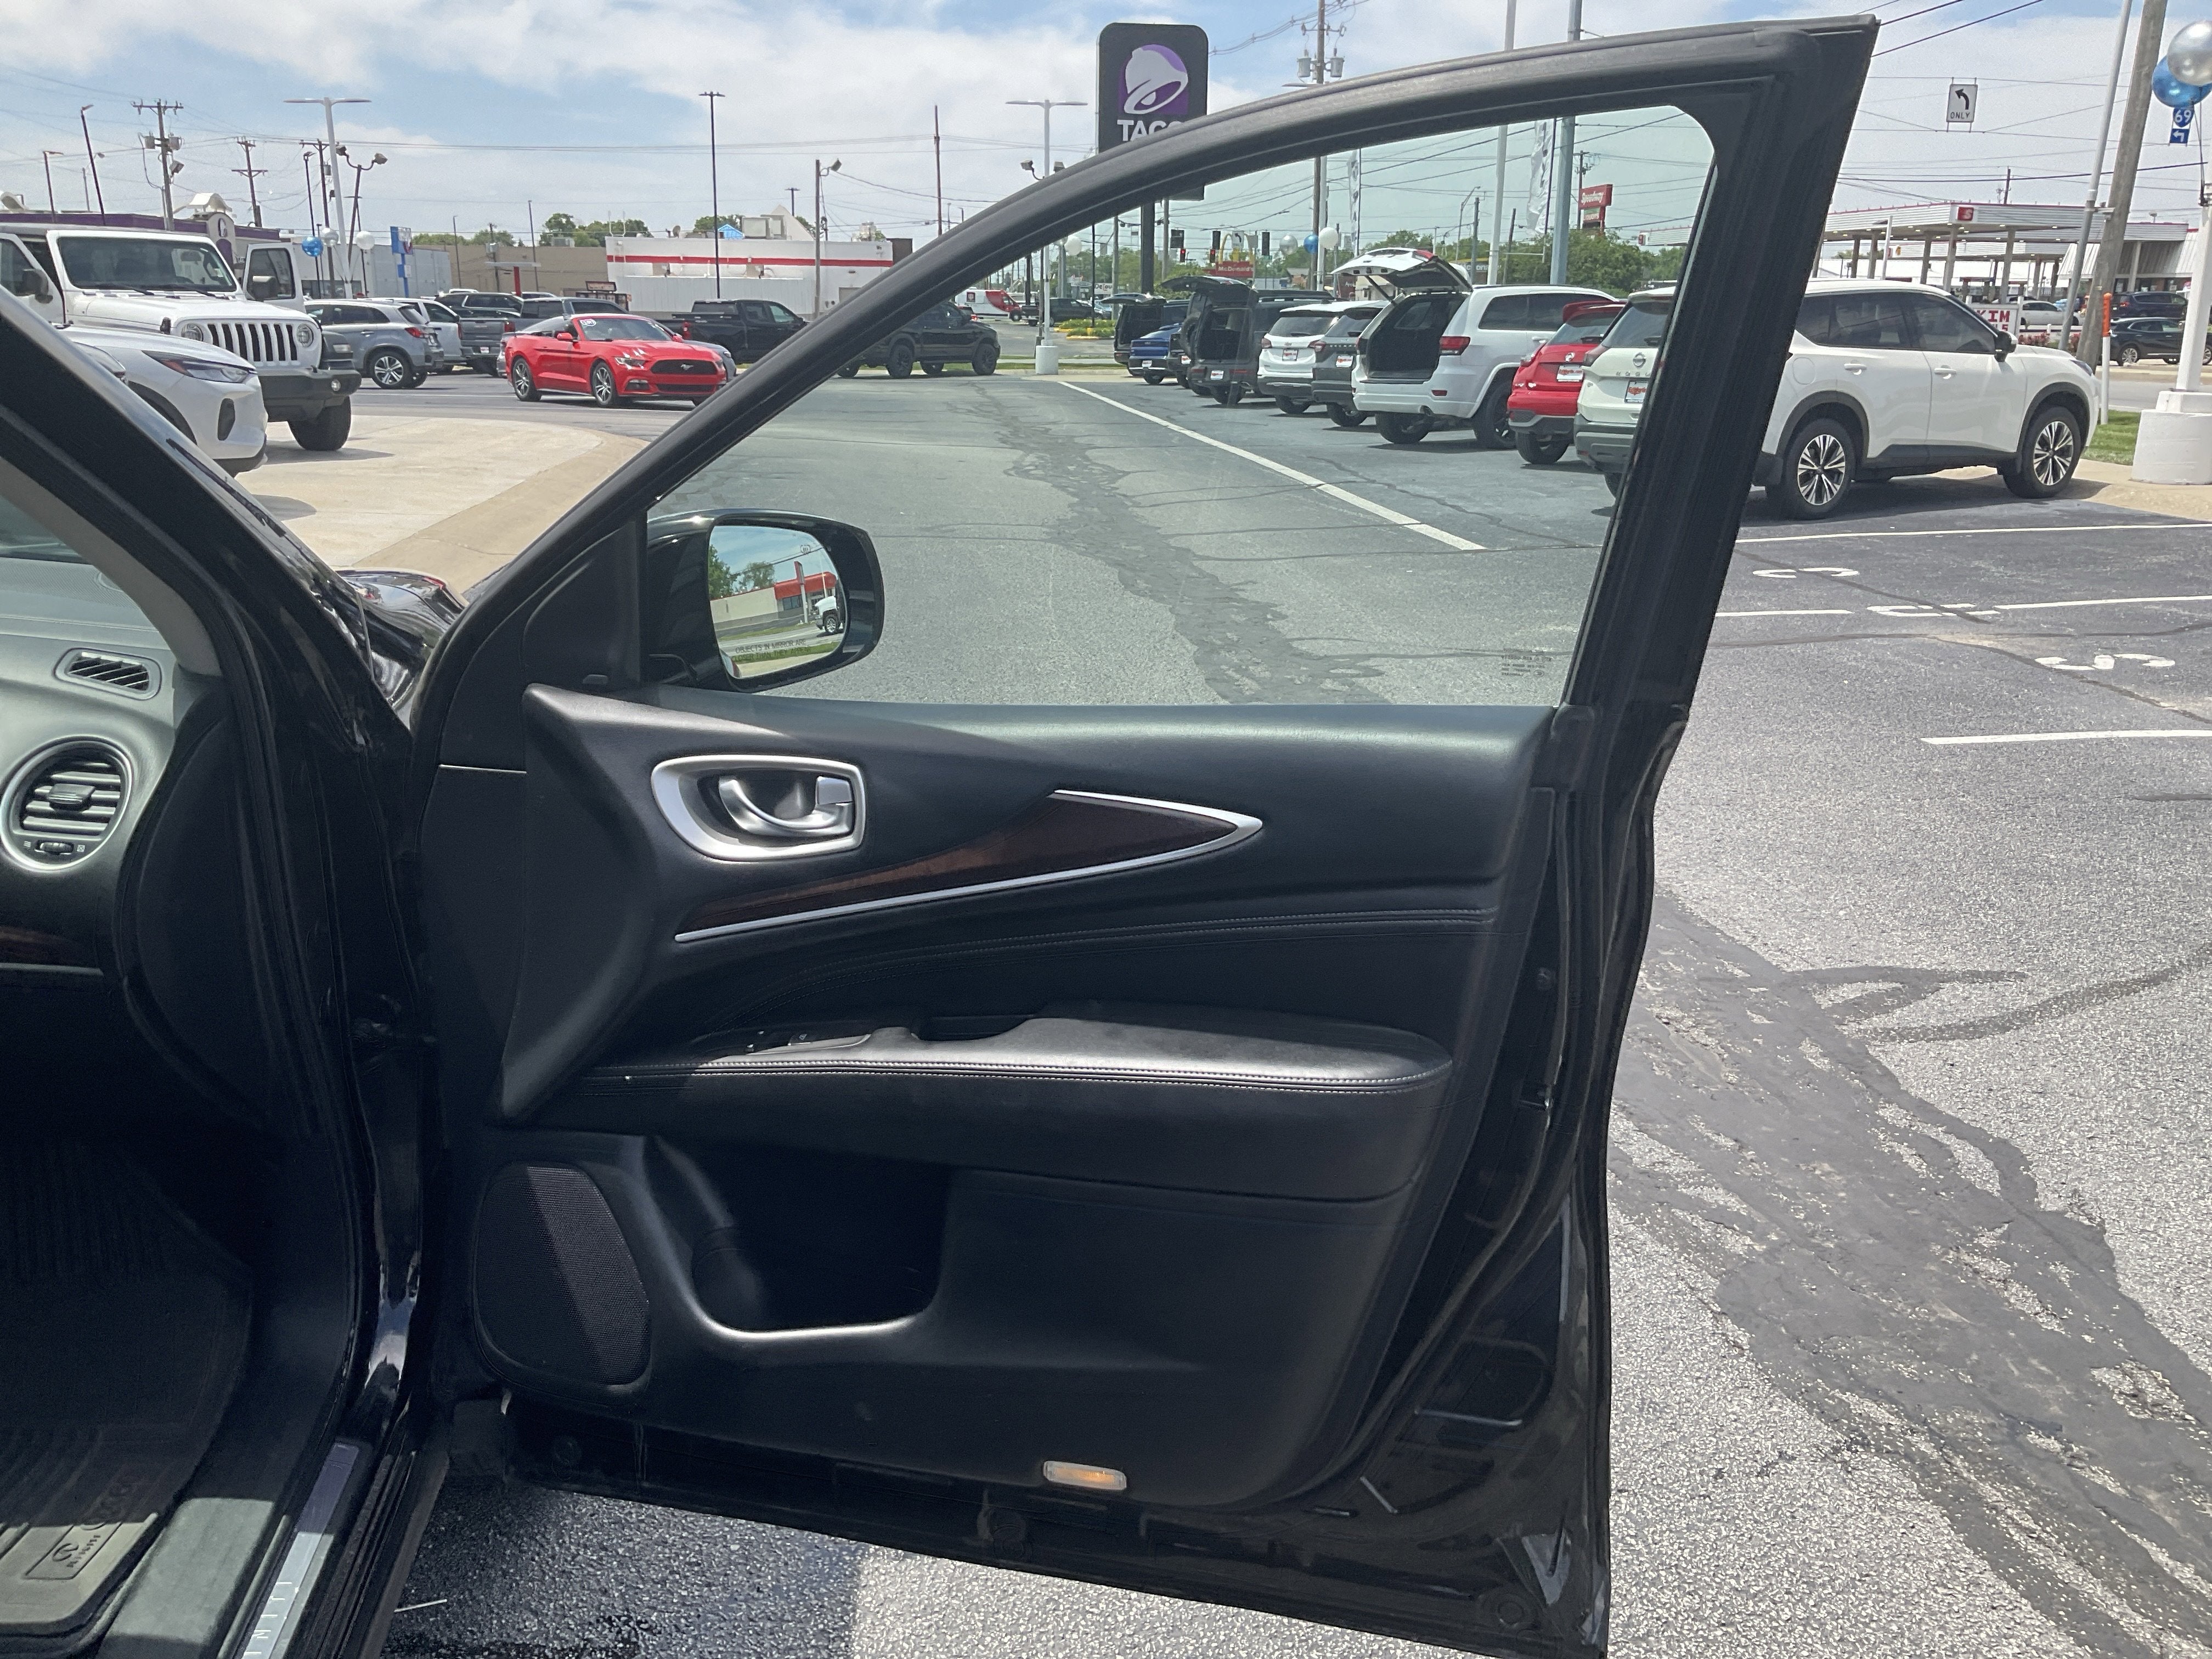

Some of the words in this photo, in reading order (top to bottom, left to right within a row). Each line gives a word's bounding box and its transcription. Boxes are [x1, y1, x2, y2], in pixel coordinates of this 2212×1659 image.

[2174, 110, 2192, 123] 69
[1117, 120, 1183, 142] TAC
[735, 644, 762, 654] OBJECTS
[771, 640, 793, 649] MIRROR
[732, 653, 754, 663] CLOSER
[774, 650, 788, 658] THEY
